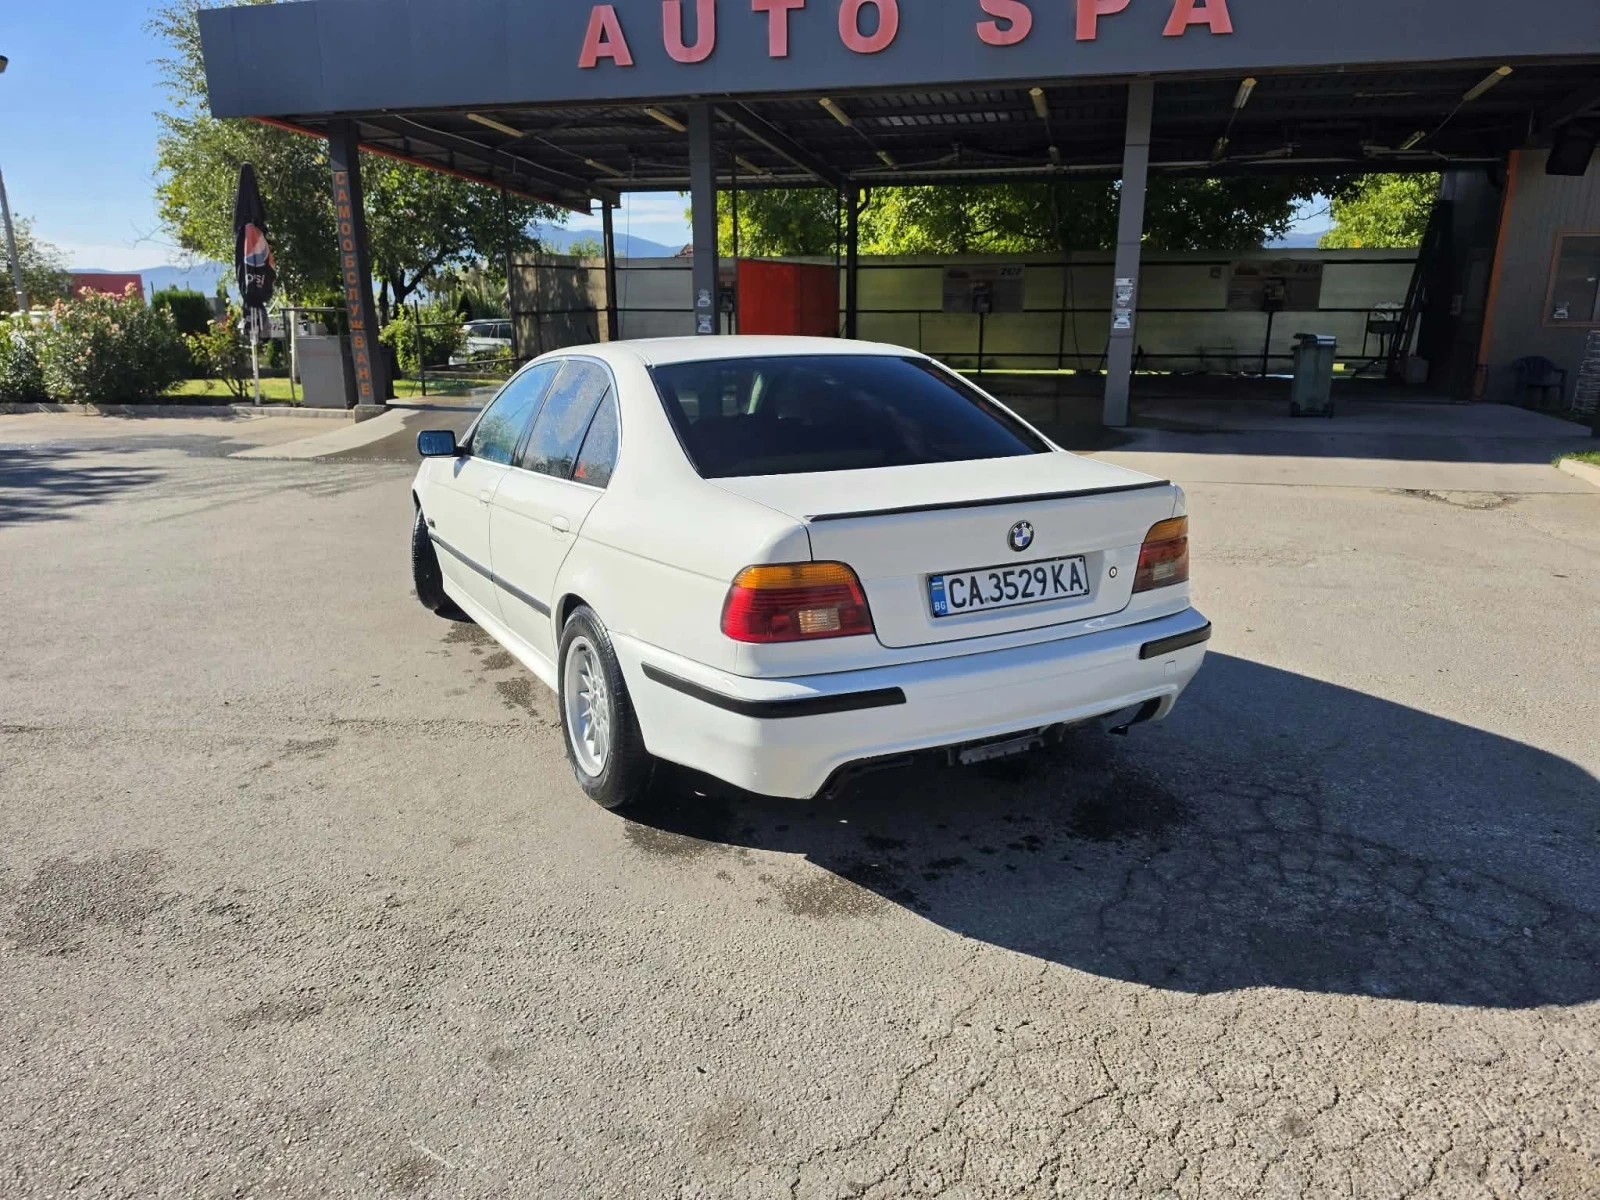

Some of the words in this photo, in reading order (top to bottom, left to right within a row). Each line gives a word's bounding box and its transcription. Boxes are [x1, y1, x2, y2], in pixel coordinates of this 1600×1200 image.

[578, 0, 899, 68] AUTO
[976, 0, 1233, 46] SPA
[934, 600, 947, 611] BG
